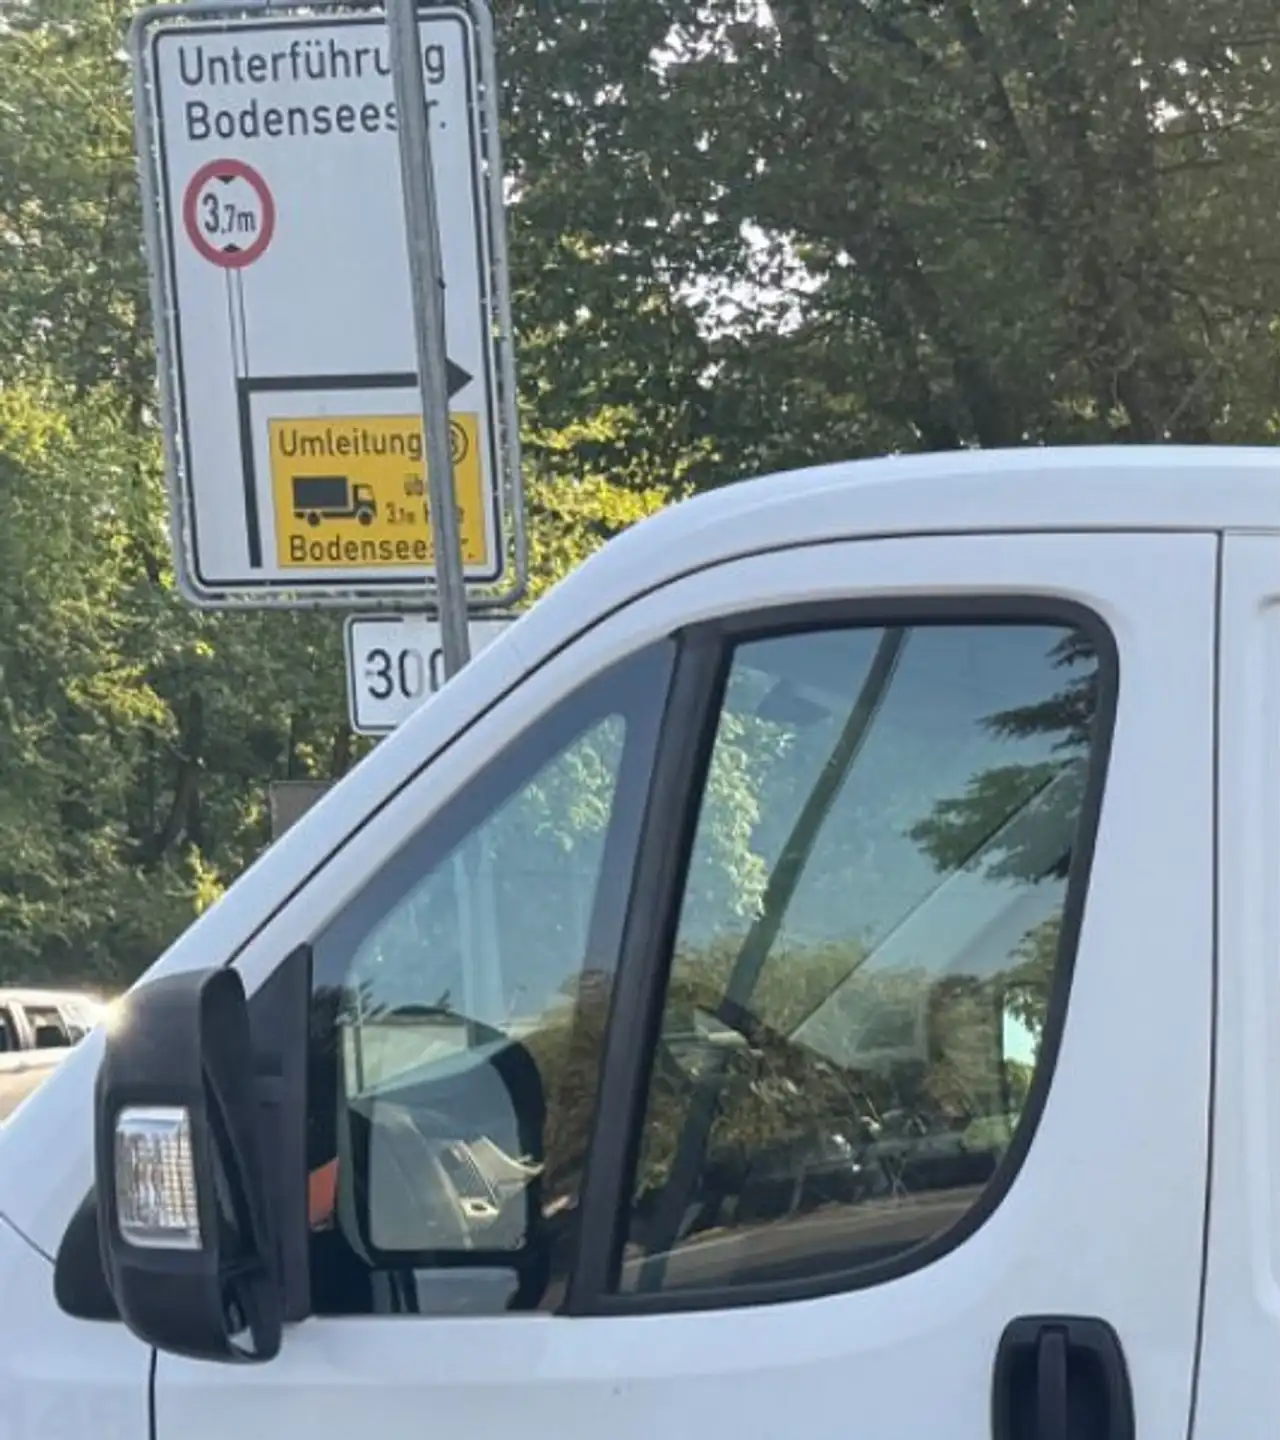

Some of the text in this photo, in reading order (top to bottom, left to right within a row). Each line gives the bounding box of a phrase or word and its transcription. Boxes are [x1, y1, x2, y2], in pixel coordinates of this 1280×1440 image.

[178, 38, 446, 86] Unterführug
[185, 98, 447, 141] Bodenseesr.
[202, 192, 257, 236] 3,7m
[278, 426, 423, 462] Umleitung
